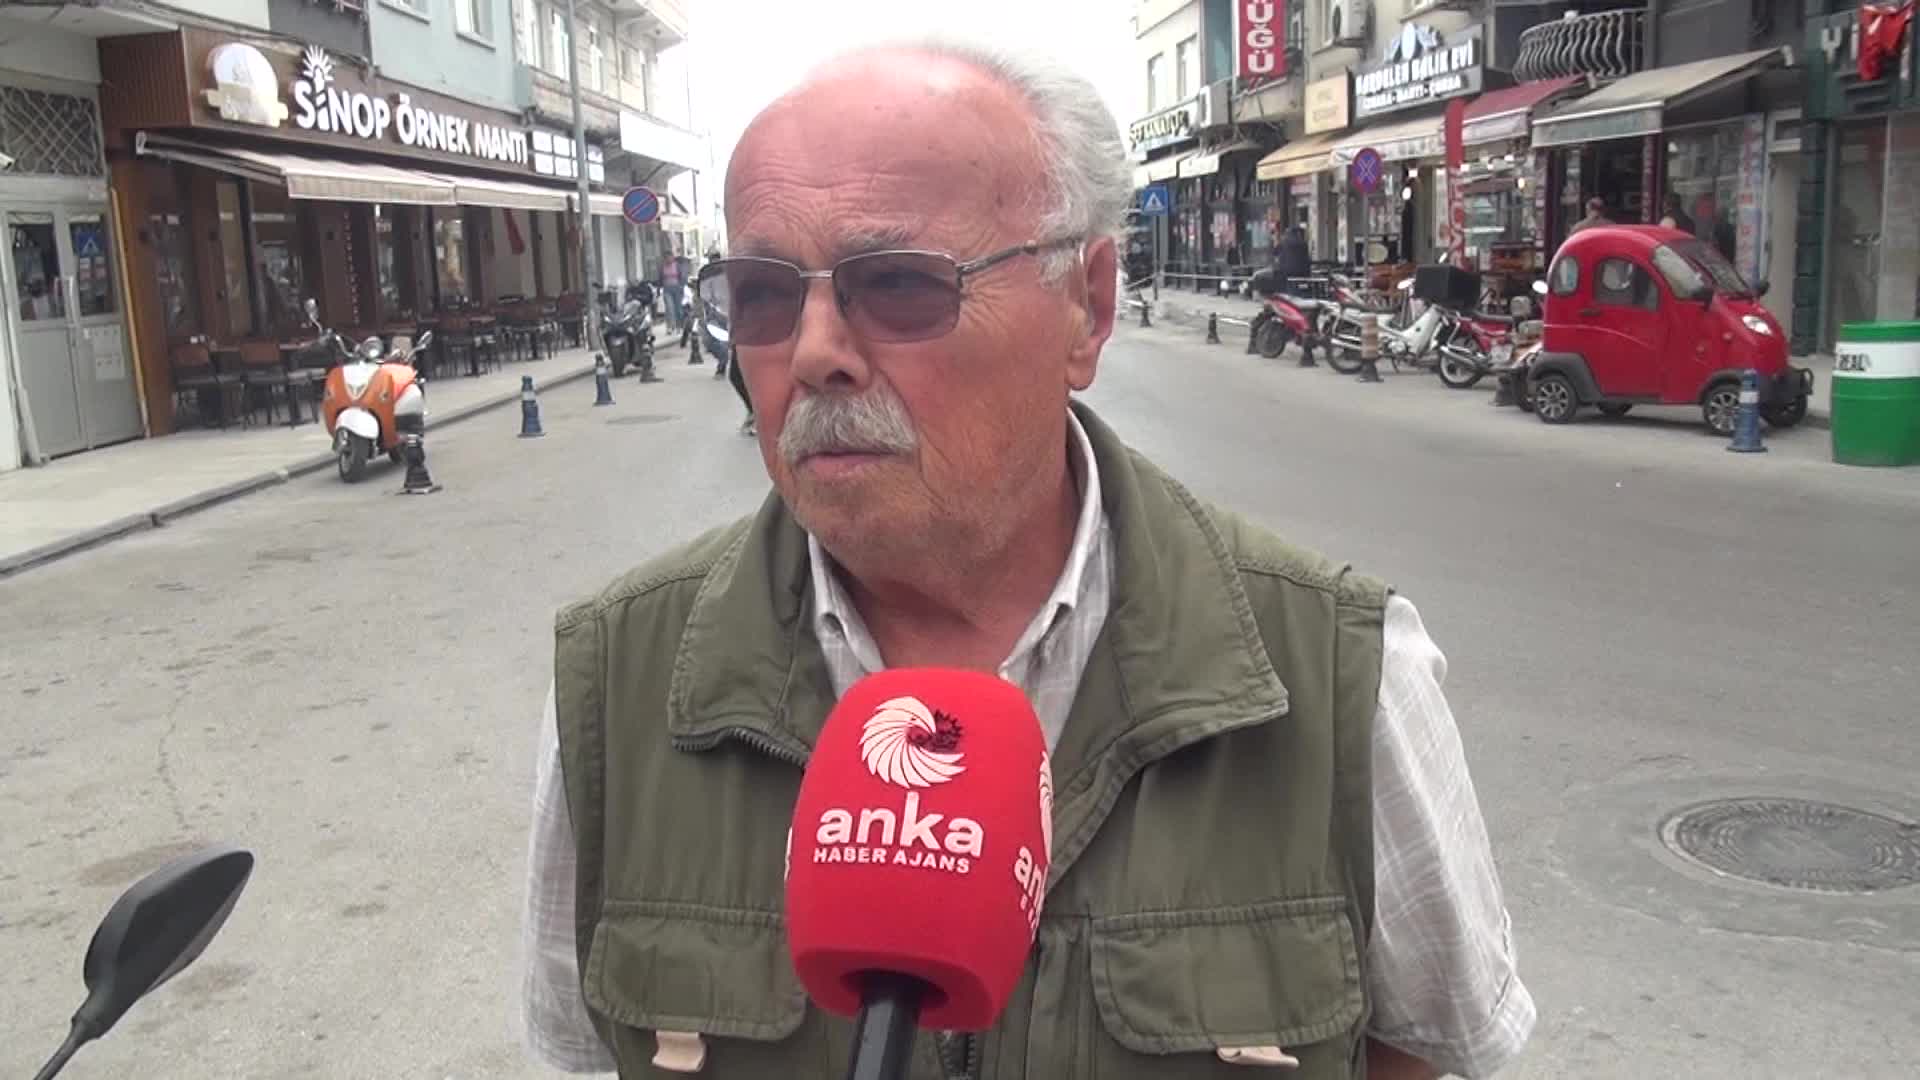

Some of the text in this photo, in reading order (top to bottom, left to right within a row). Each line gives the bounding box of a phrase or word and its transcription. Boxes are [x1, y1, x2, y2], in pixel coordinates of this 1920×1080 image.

[1411, 50, 1449, 82] BALIK
[293, 66, 528, 165] SİNOP ÖRNEK MANTI
[815, 791, 985, 858] anka
[813, 846, 970, 874] HABER AJANS
[1013, 845, 1049, 913] an
